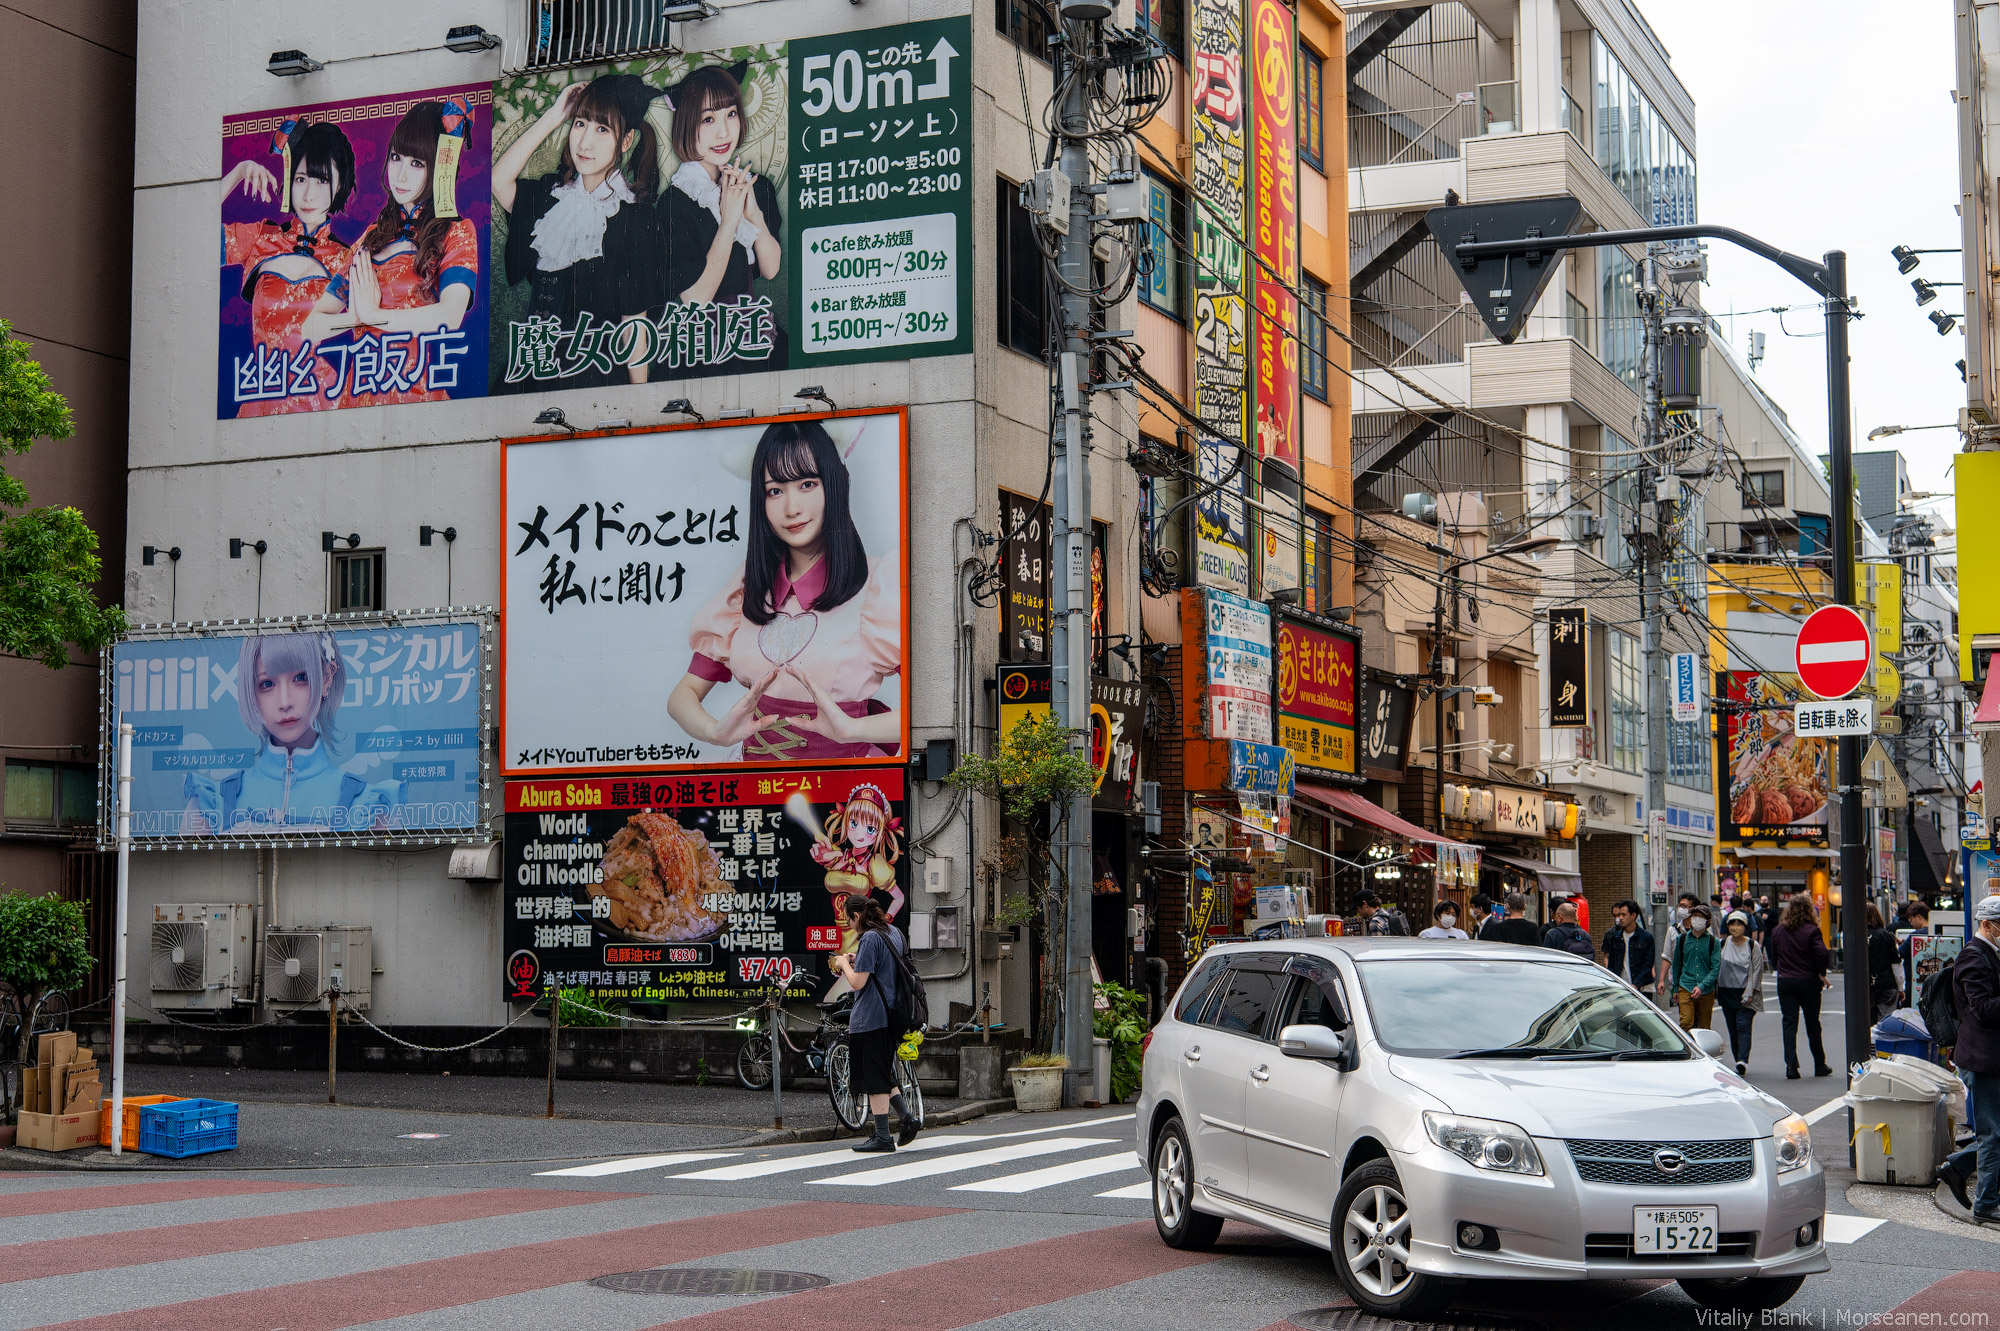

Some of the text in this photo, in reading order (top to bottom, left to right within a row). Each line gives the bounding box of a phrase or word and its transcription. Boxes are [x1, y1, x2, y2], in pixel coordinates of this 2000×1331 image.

[865, 41, 922, 68] この先
[801, 49, 913, 117] 50m
[1193, 54, 1243, 117] アニメ
[799, 162, 832, 184] 平日
[1258, 114, 1274, 248] Akibaoo
[799, 186, 833, 209] 休日
[504, 294, 773, 383] 魔女の箱庭
[1196, 295, 1228, 363] 2階
[1261, 287, 1277, 396] Power
[1229, 352, 1243, 370] HOME
[1207, 366, 1242, 387] ELECTRONICS
[514, 501, 740, 557] メイドのことは
[1198, 550, 1224, 577] GREEN
[1224, 560, 1248, 585] HOUSE
[539, 553, 686, 614] 私に聞け
[1211, 602, 1226, 632] 3F
[343, 630, 476, 674] マジカル
[1553, 616, 1580, 708] 刺身
[1213, 650, 1229, 679] 2F
[1299, 689, 1354, 717] www.akibaoo.co.jp
[1218, 700, 1233, 731] 1F
[1553, 714, 1584, 722] SASHIMI
[1799, 702, 1868, 731] 自転車を除く
[367, 735, 423, 748] プロデュース
[427, 734, 440, 748] by
[163, 752, 245, 766] マジカルロリポップ
[517, 742, 700, 766] メイドYouTuberももちゃん
[1246, 744, 1269, 766] 3F への
[1310, 754, 1321, 763] ZERO
[1246, 769, 1258, 790] 2F
[520, 784, 601, 807] Abura Soba
[611, 780, 738, 806] 最強の油そば
[130, 801, 477, 833] IMITED COLLABORATION
[539, 813, 587, 836] World
[717, 808, 782, 834] 世界で
[523, 838, 603, 865] champion
[709, 832, 791, 856] 一番旨い
[518, 863, 604, 885] Oil Noodle
[719, 857, 780, 881] 油そば
[515, 896, 611, 919] 世界第一的
[702, 892, 802, 912] 세상에서 가장
[728, 913, 776, 931] 맛있는
[533, 924, 592, 949] 油拌面
[719, 931, 784, 952] 아부라면
[669, 949, 697, 962] ¥830
[615, 970, 651, 986] 春日亭
[659, 970, 726, 984] しょうゆ油そば
[599, 988, 628, 998] menu
[631, 986, 643, 998] of
[645, 986, 690, 999] English,
[1654, 1211, 1699, 1224] 横浜 505
[1639, 1226, 1713, 1250] つ 15-22
